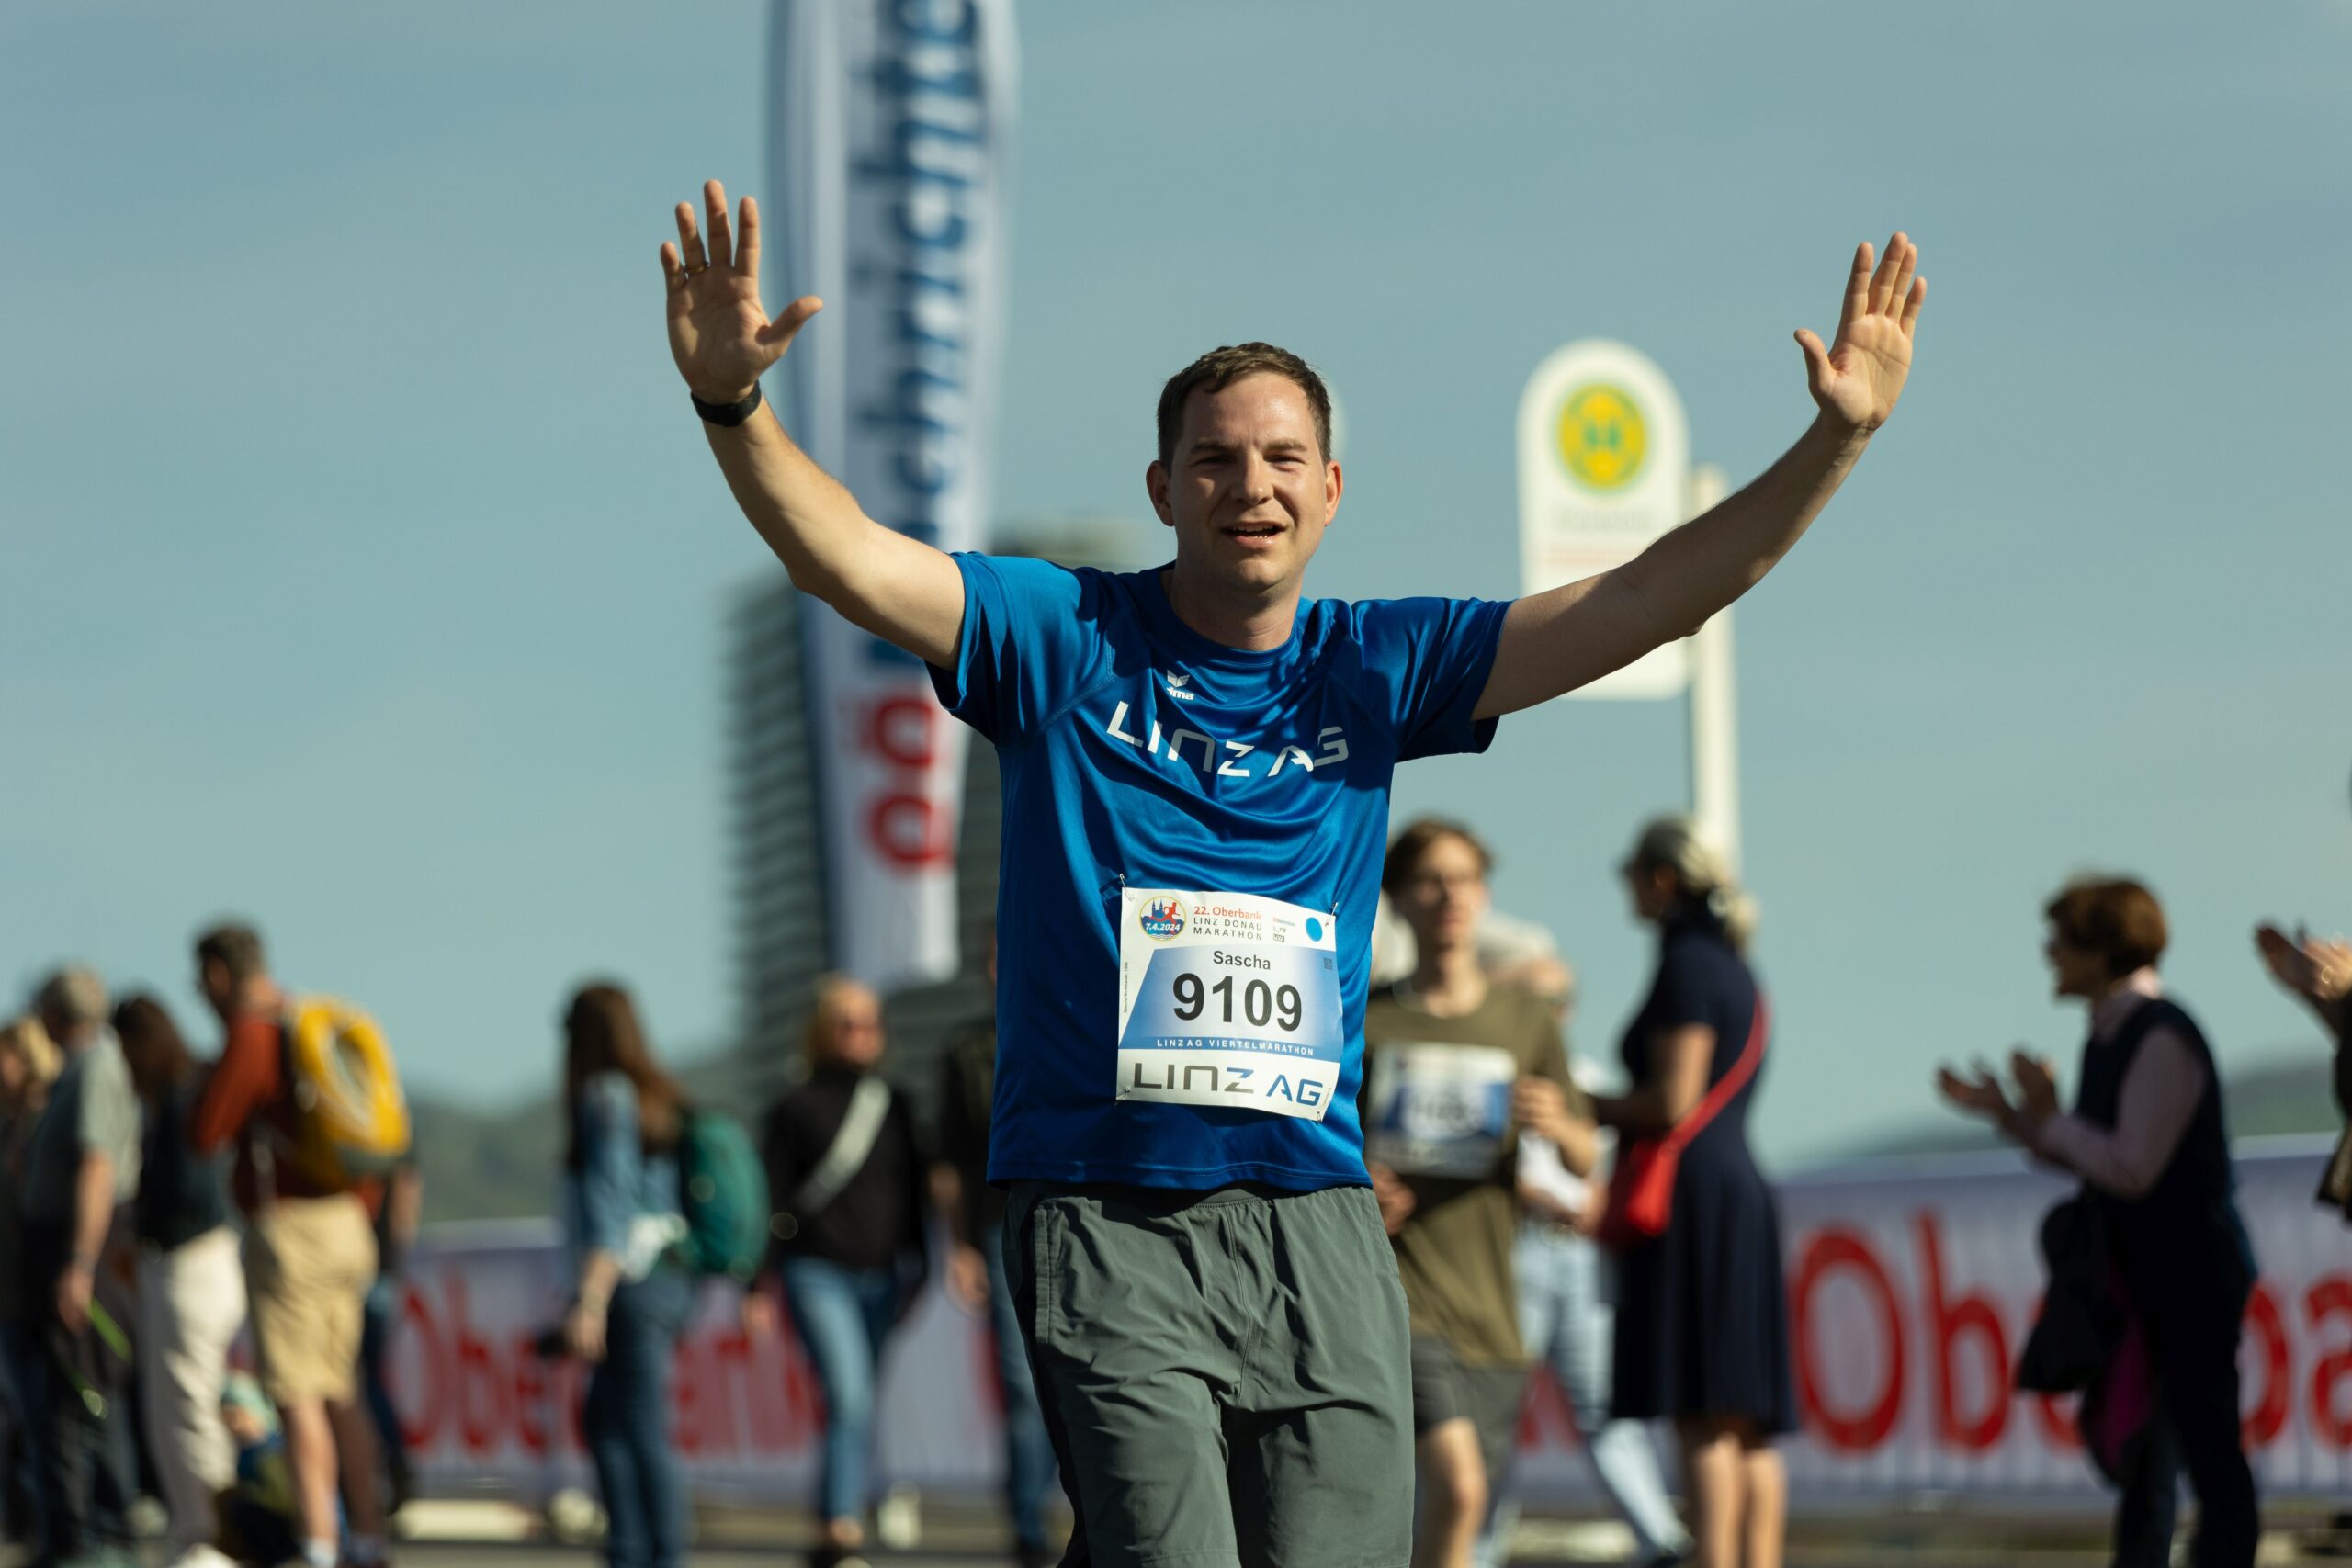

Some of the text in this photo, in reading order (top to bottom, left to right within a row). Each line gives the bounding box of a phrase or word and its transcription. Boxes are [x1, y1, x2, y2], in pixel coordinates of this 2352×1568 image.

[1107, 701, 1349, 777] LINZ AG
[1194, 906, 1262, 920] 22. Oberbank
[1146, 922, 1181, 931] 7.4.2024
[1193, 917, 1218, 926] LINZ
[1224, 919, 1262, 931] DONAU
[1193, 927, 1262, 941] MARATHON
[1213, 950, 1271, 970] Sascha
[1172, 972, 1303, 1032] 9109
[1209, 1039, 1314, 1056] VIERTELMARATHON
[1134, 1063, 1324, 1107] LINZ AG
